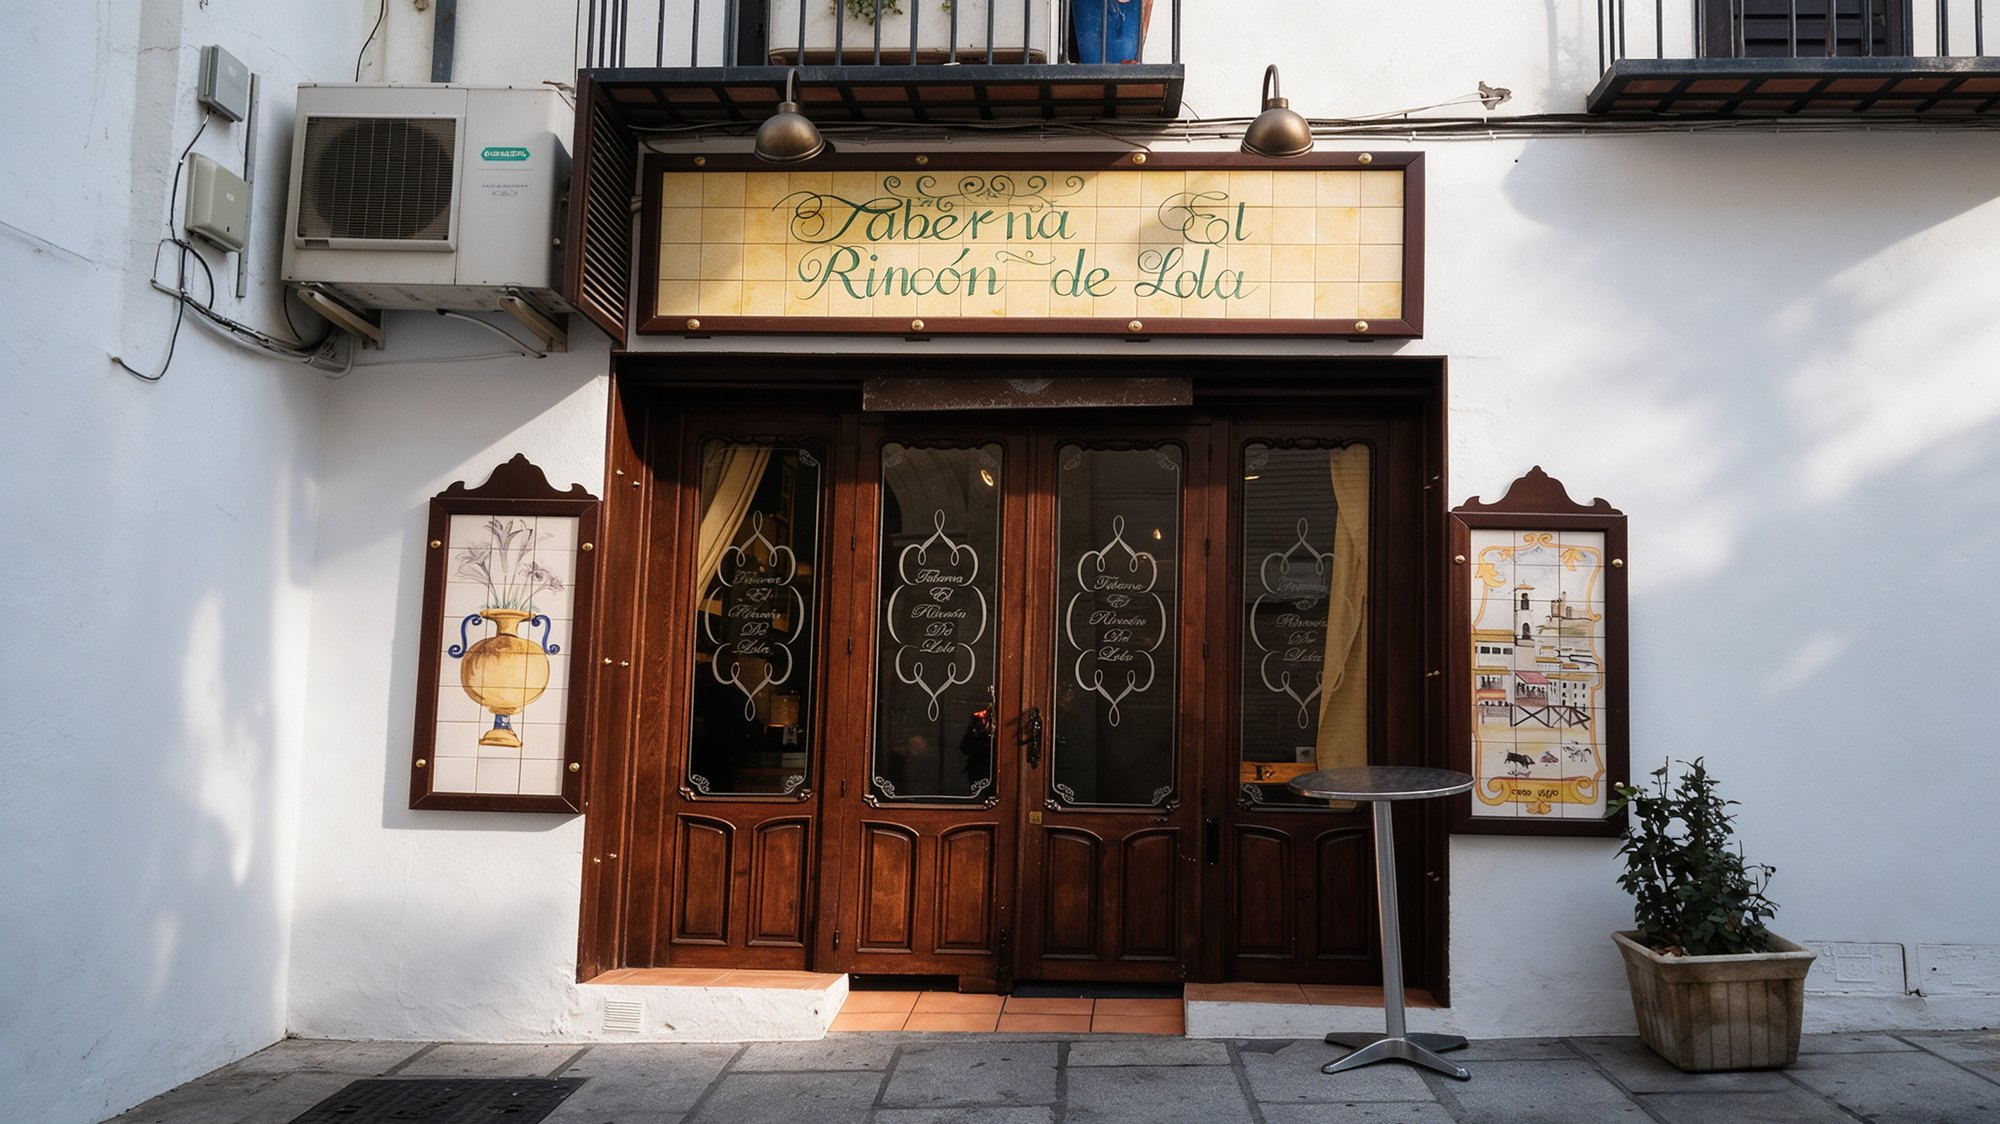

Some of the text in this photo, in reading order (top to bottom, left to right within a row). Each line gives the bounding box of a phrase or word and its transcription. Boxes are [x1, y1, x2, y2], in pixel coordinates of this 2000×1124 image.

[772, 191, 1252, 248] Taberna El
[795, 244, 1261, 300] Rincón de Lola
